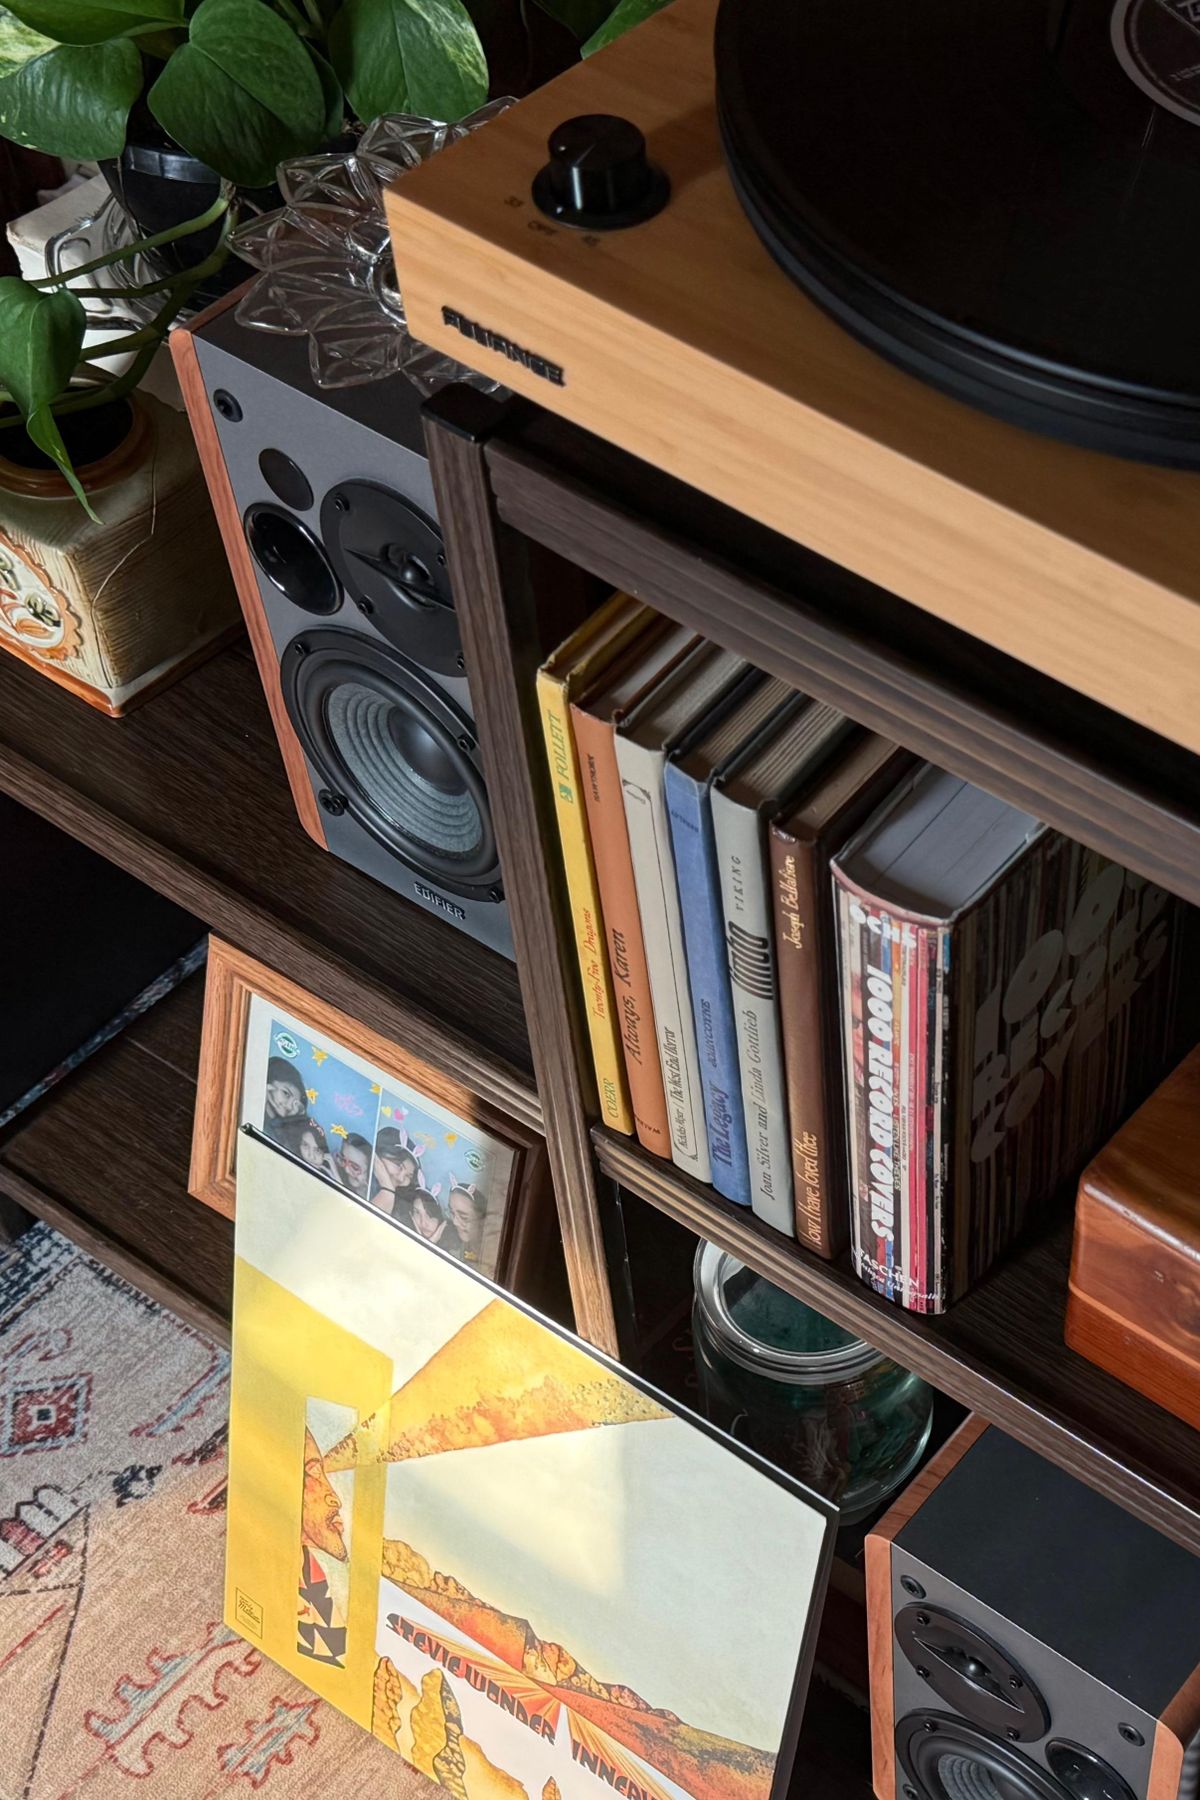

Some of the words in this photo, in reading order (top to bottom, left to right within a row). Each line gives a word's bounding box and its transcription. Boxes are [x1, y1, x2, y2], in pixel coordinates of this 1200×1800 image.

[441, 305, 566, 387] FLUANCE
[547, 709, 569, 780] FOLLETT
[413, 881, 466, 921] EDIFIER
[731, 855, 744, 912] VIKING
[583, 908, 597, 954] Dragons
[781, 911, 805, 949] Joseph
[849, 901, 917, 948] OCHS
[612, 928, 631, 988] Karen
[866, 964, 893, 1042] 1000
[622, 995, 643, 1065] Always,
[664, 1026, 678, 1056] Horror
[743, 1008, 762, 1064] Gottlieb
[666, 1051, 681, 1071] End
[667, 1067, 682, 1089] West
[603, 1077, 619, 1119] COERR
[670, 1084, 684, 1103] The
[749, 1069, 765, 1105] Linda
[867, 1040, 894, 1147] RECORD
[709, 1080, 733, 1140] Legacy
[753, 1103, 768, 1130] and
[711, 1138, 732, 1168] The
[756, 1131, 771, 1170] Silver
[793, 1130, 817, 1161] thee
[759, 1171, 775, 1201] Joan
[796, 1152, 820, 1189] loved
[798, 1185, 821, 1215] have
[869, 1149, 894, 1242] COVERS
[855, 1247, 920, 1288] TASCHEN
[386, 1613, 466, 1678] STEVIE
[464, 1663, 556, 1746] WONDER
